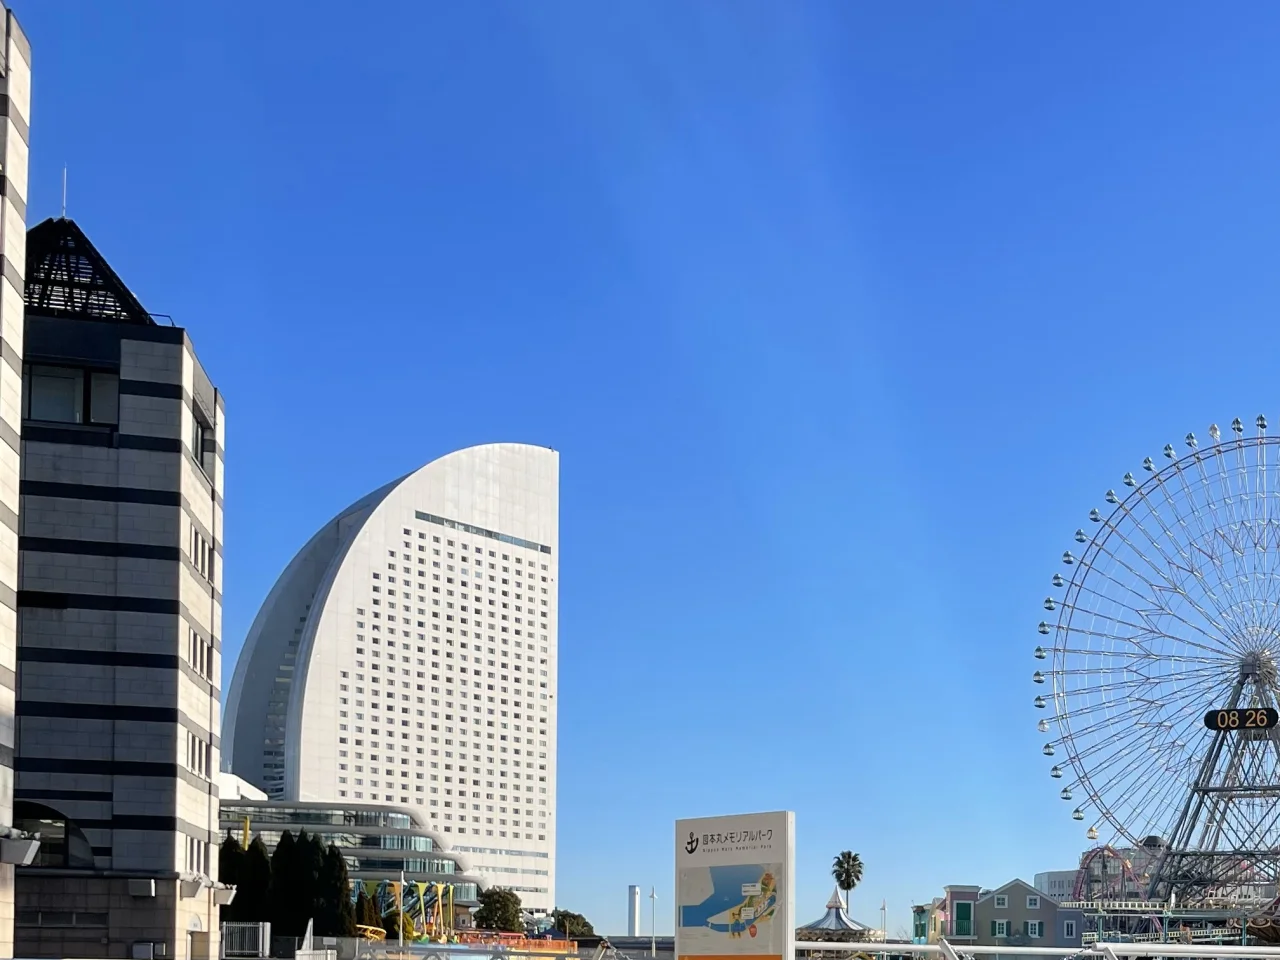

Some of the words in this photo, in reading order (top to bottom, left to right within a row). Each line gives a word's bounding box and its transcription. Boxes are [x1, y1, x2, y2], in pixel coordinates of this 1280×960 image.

[1217, 711, 1239, 728] 08
[1245, 709, 1268, 727] 26
[703, 829, 773, 845] 日本丸メモリアルパーク
